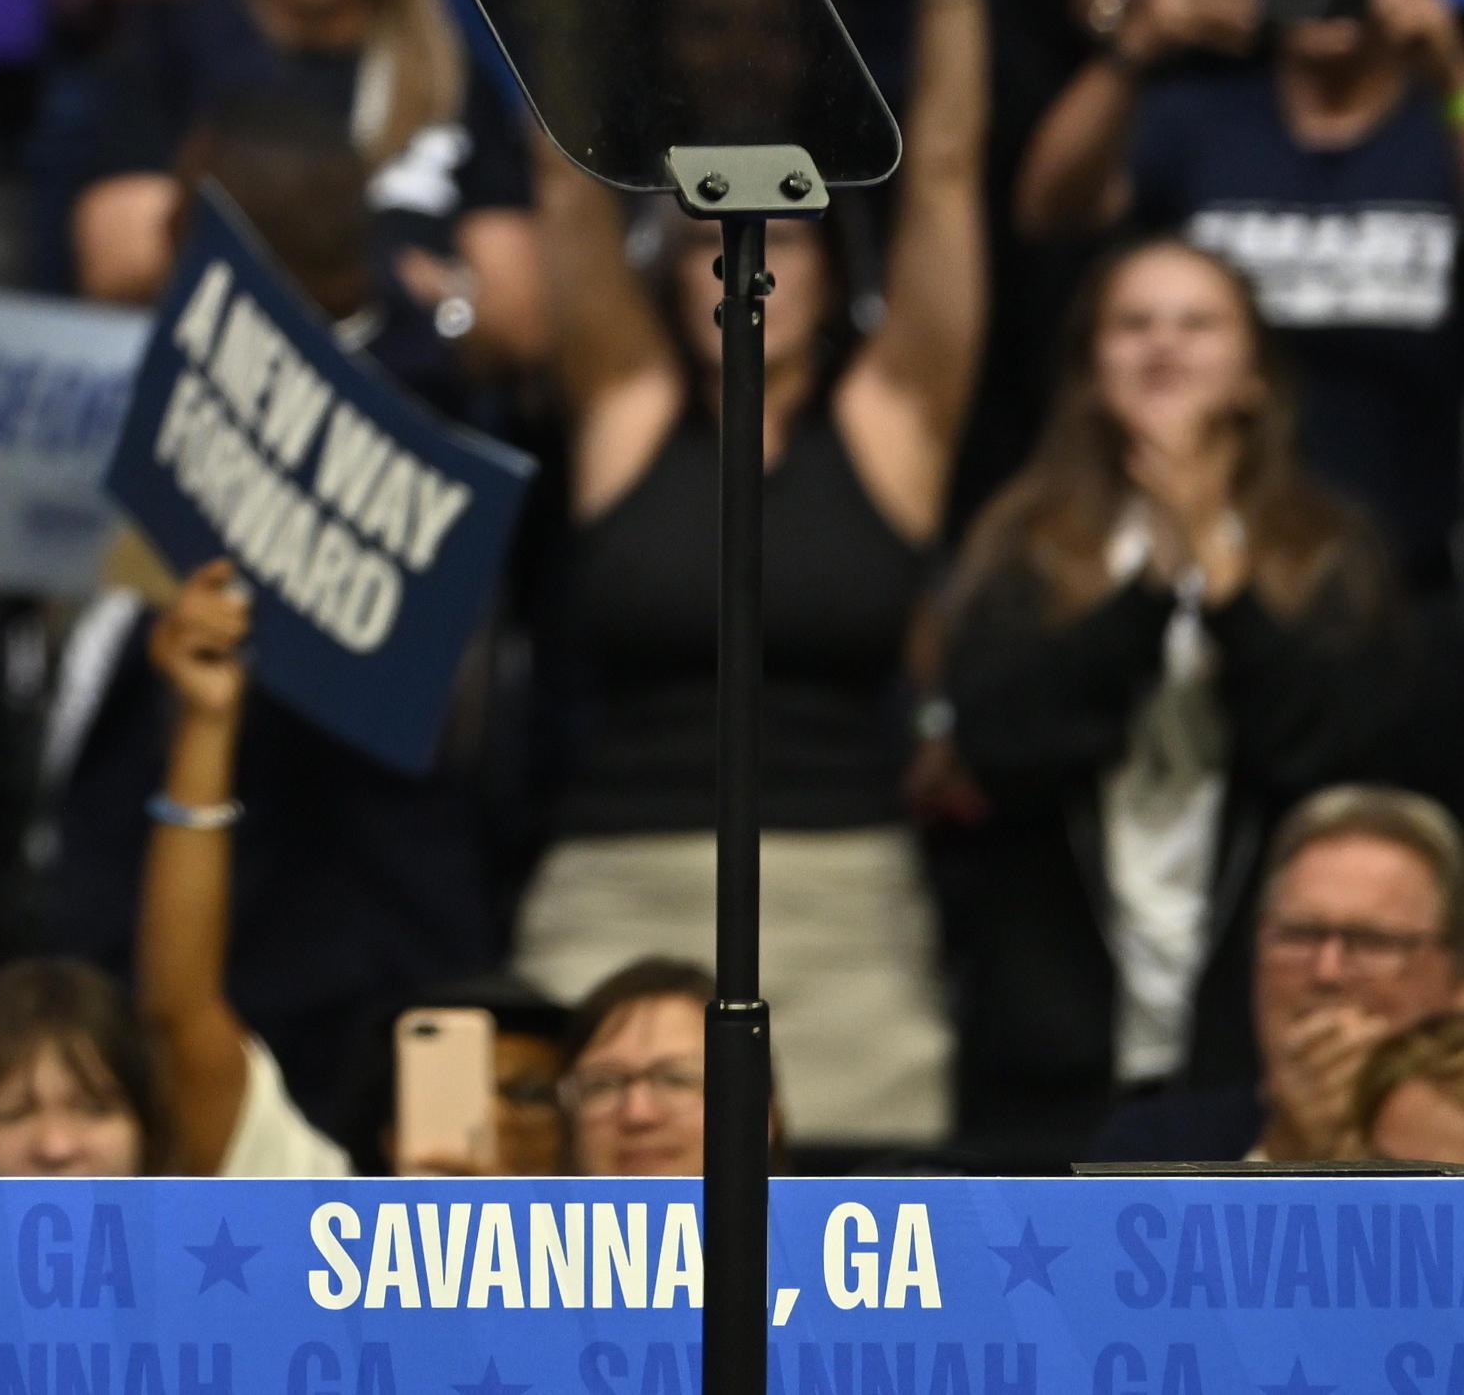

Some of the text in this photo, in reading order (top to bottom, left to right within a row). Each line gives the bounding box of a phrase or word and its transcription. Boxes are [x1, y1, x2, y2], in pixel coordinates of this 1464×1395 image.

[175, 259, 473, 574] A NEW WAY
[154, 373, 406, 656] FORWARD
[18, 1201, 138, 1310] GA
[308, 1201, 942, 1326] SAVANNA, GA
[1113, 1202, 1464, 1310] SAVANN
[286, 1340, 406, 1395] GA
[1093, 1340, 1205, 1395] GA
